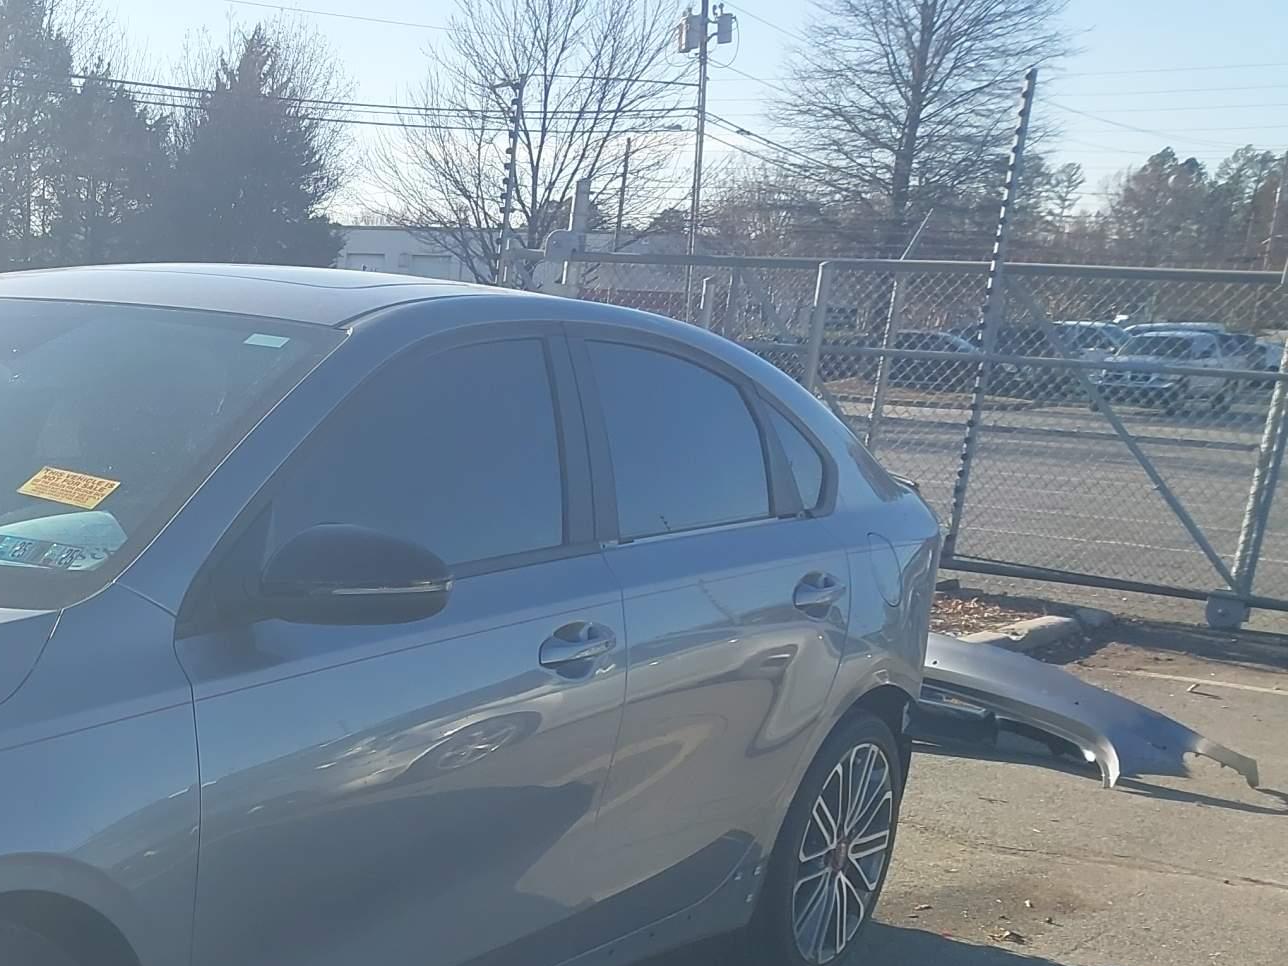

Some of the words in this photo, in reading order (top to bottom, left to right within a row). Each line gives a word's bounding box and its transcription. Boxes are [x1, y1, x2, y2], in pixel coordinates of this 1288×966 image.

[44, 468, 65, 477] THIS
[66, 473, 105, 486] VEHICLE
[61, 479, 81, 487] FOR
[81, 483, 107, 493] SALE
